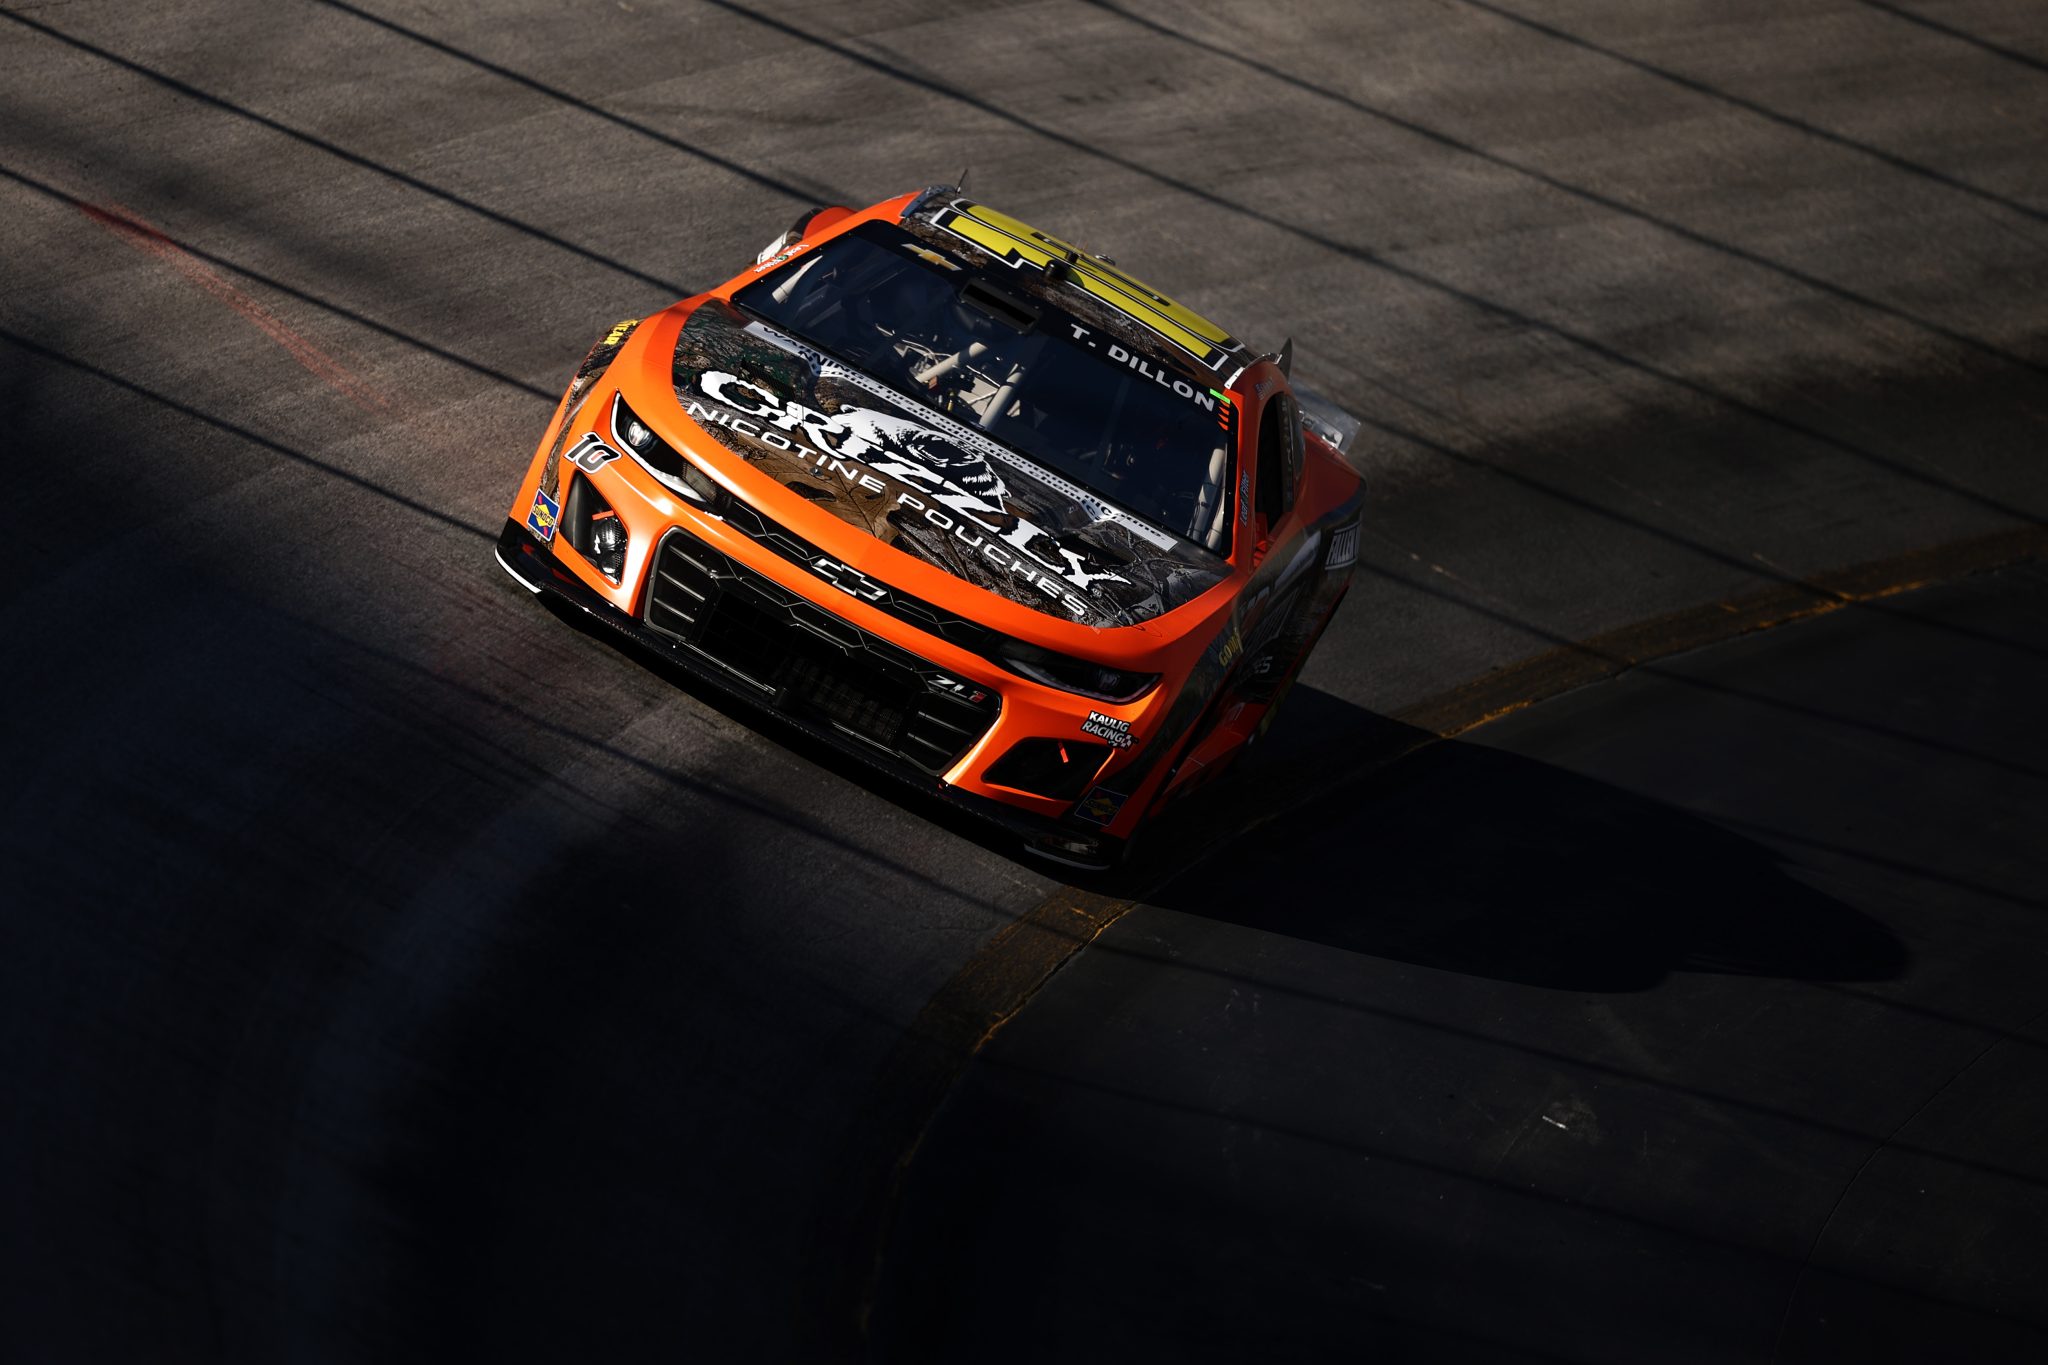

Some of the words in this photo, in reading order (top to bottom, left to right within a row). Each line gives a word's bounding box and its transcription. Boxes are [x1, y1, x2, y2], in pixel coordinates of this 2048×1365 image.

[1107, 344, 1215, 412] DILLON
[564, 431, 622, 474] 10
[700, 370, 1131, 590] GRIZZLY
[533, 504, 555, 527] SUNOCO
[687, 402, 887, 494] NICOTINE
[896, 492, 1088, 617] POUCHES
[928, 674, 987, 704] ZL1
[1081, 720, 1127, 745] RACING
[1088, 711, 1131, 733] KAULIG
